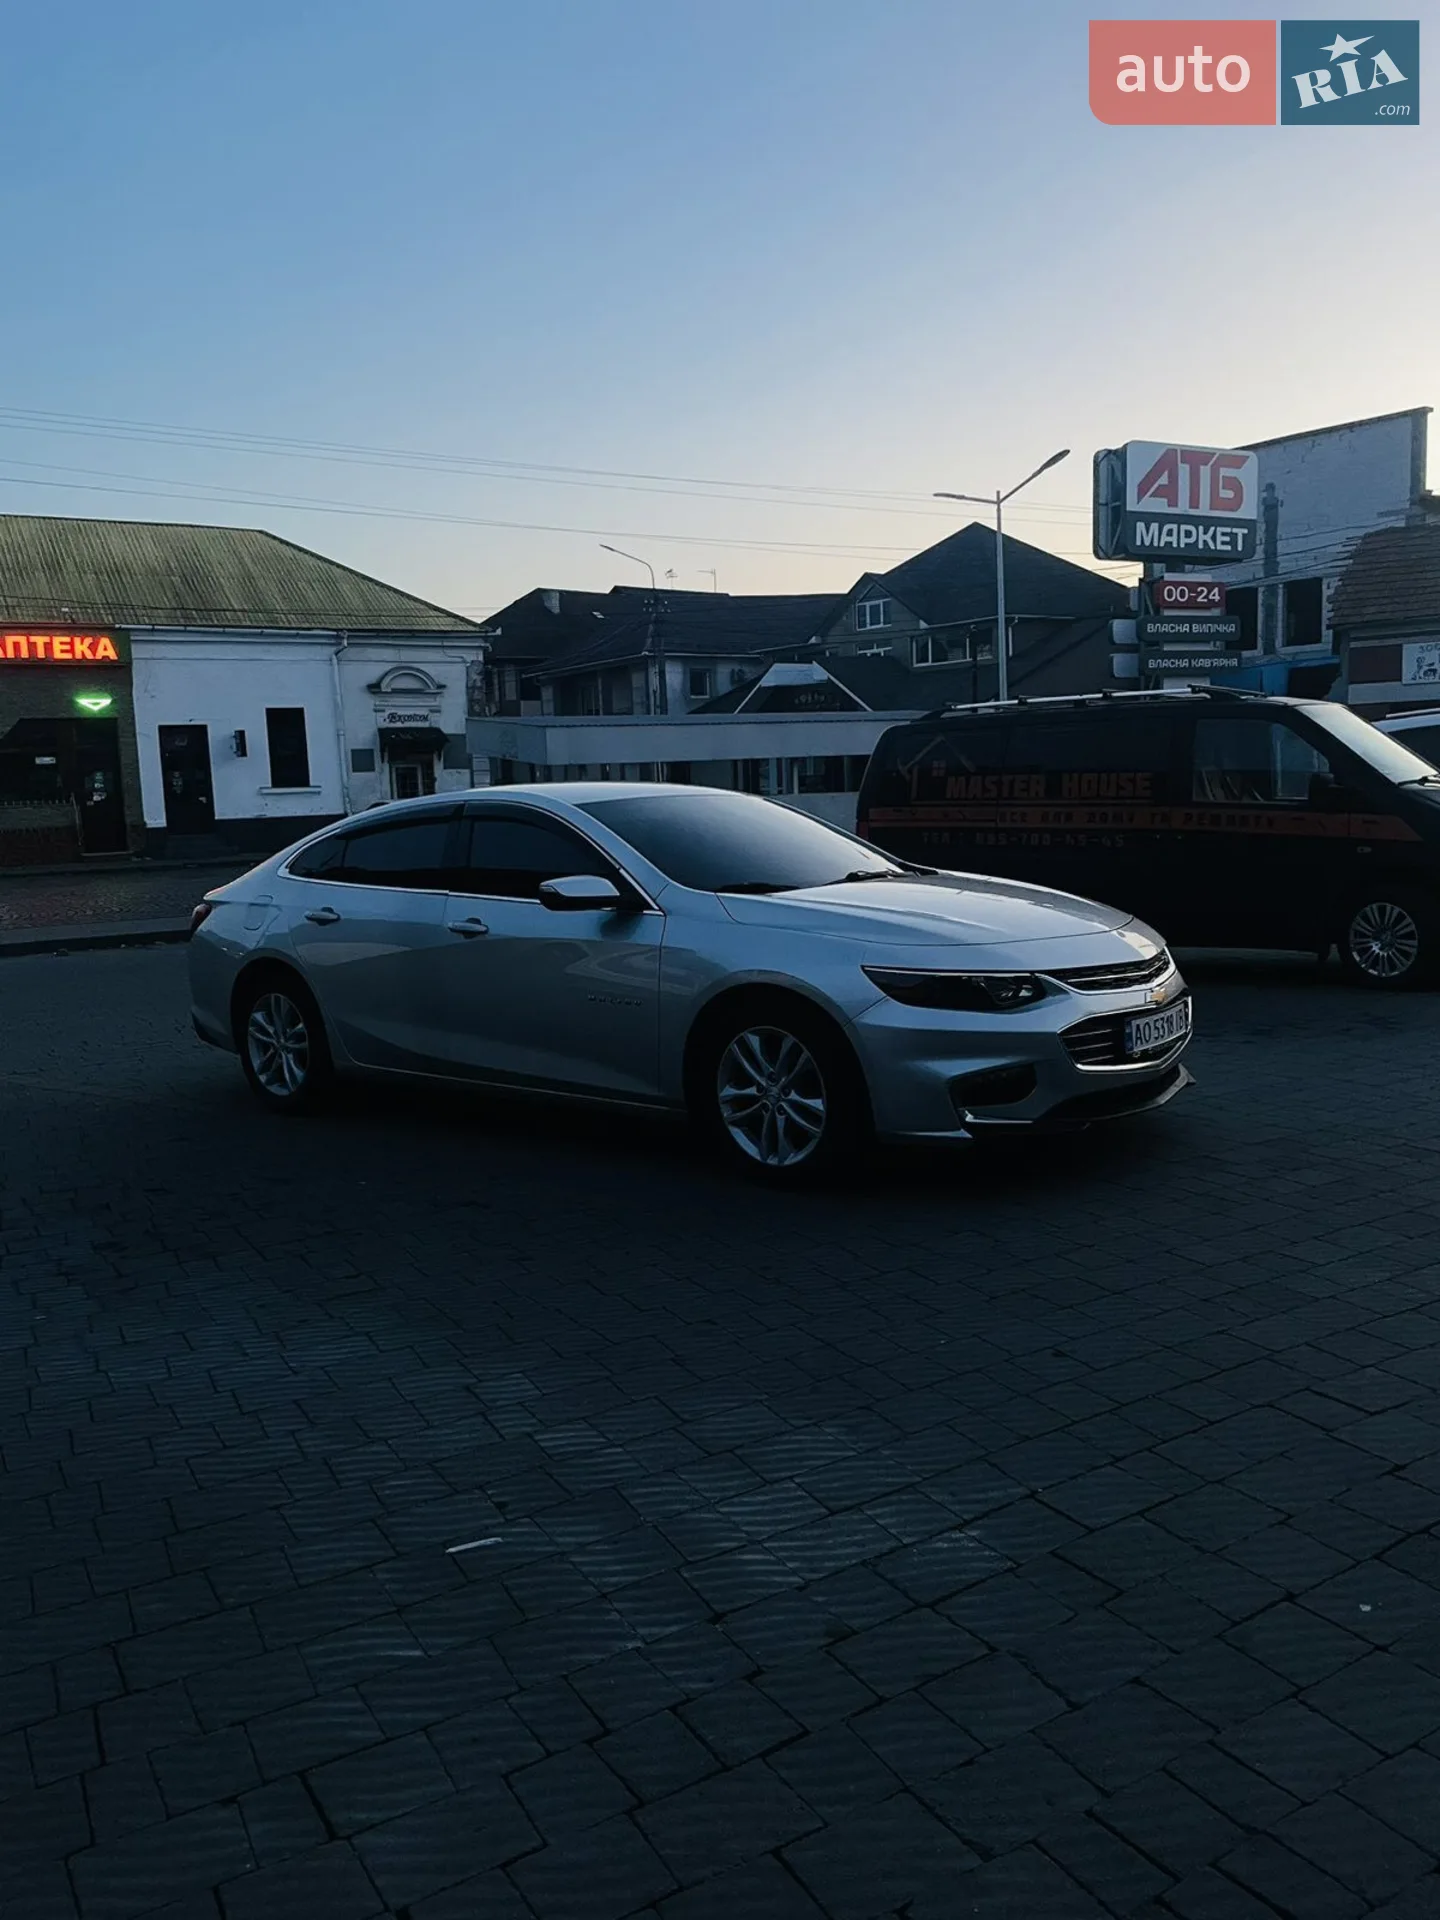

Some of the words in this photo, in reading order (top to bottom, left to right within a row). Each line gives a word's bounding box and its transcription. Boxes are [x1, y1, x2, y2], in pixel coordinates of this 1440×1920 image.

[1136, 448, 1250, 513] АТБ
[1135, 520, 1249, 552] МАРКЕТ
[1163, 585, 1221, 604] 00-24
[1146, 622, 1190, 634] ВЛАСНА
[1191, 622, 1236, 634] ВИПІЧКА
[1147, 657, 1189, 669] ВЛАСНА
[945, 773, 1047, 800] MASTER
[1061, 772, 1154, 799] HOUSE
